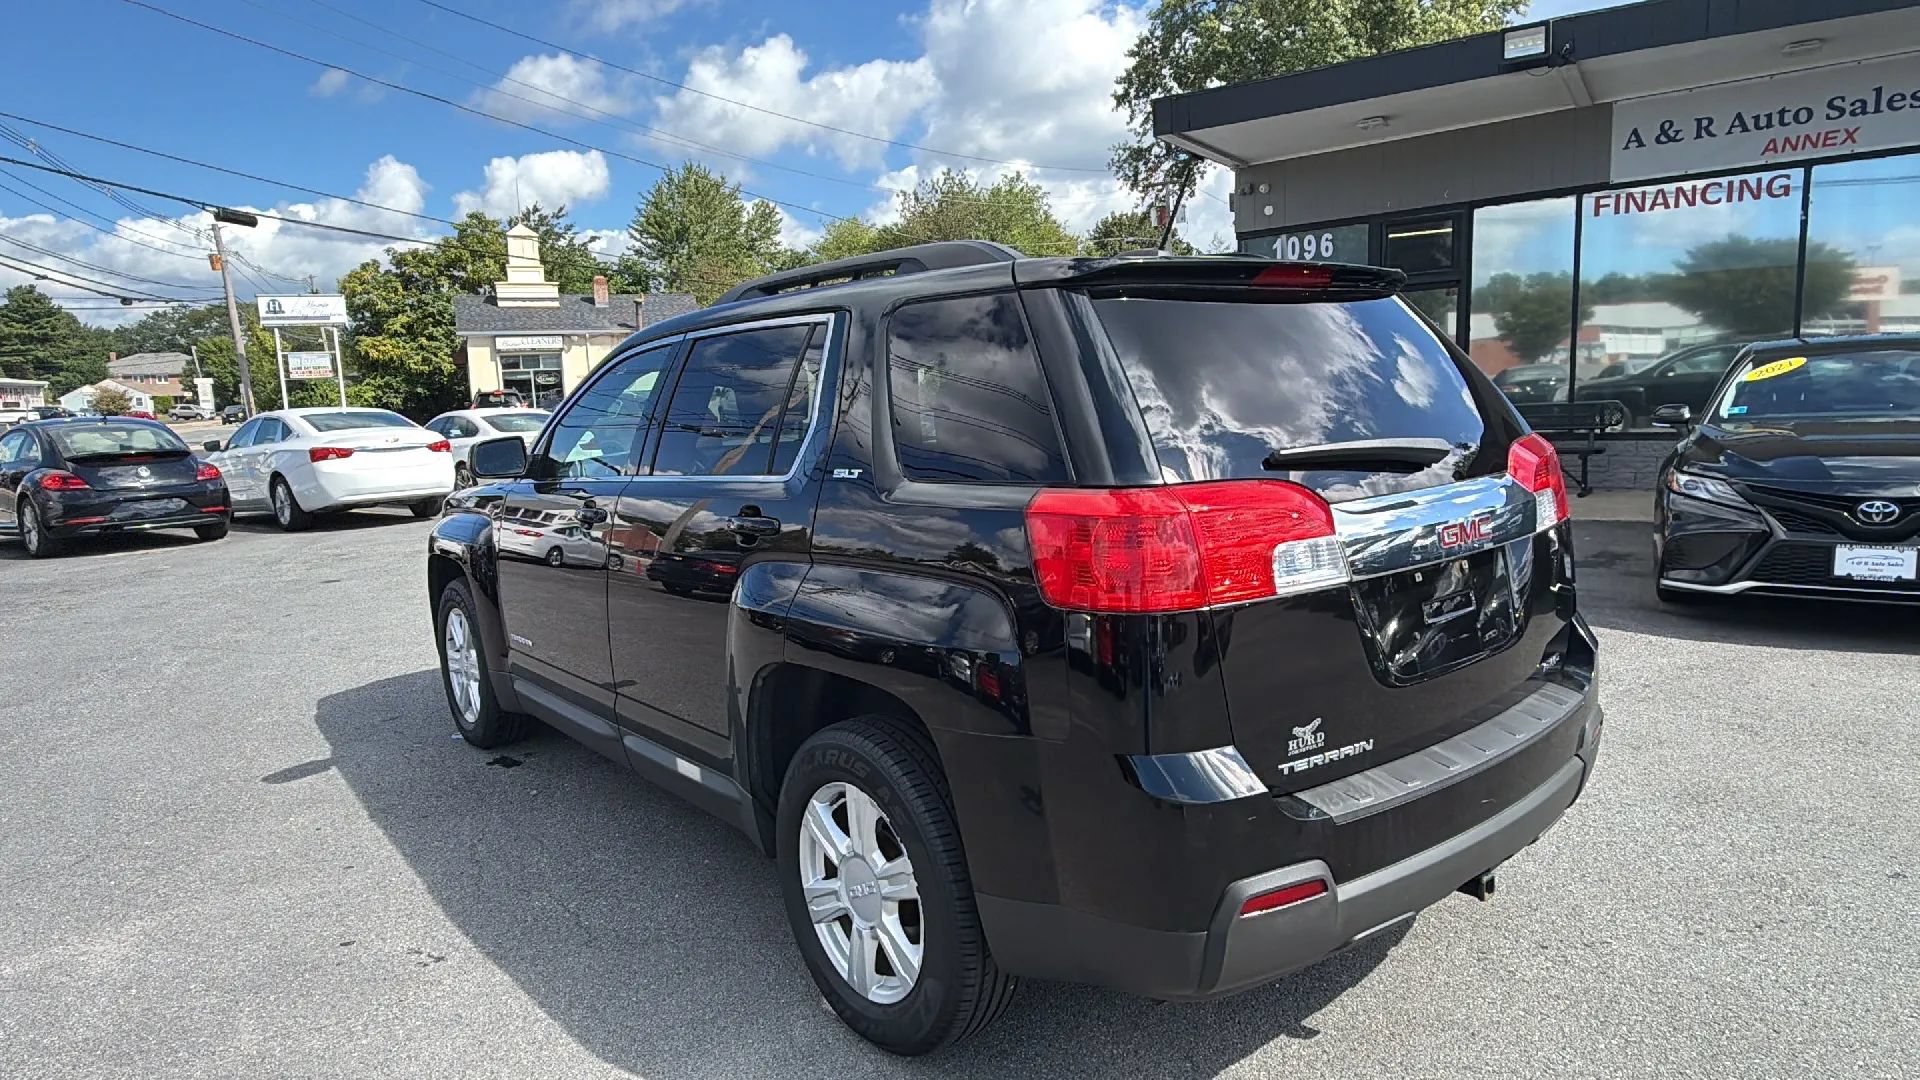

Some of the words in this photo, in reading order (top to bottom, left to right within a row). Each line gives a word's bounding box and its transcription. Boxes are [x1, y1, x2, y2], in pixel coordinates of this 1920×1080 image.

[1622, 127, 1647, 150] A
[1654, 119, 1684, 145] &
[1693, 116, 1718, 141] R
[1725, 105, 1815, 136] Auto
[1760, 126, 1862, 156] ANNEX
[1593, 173, 1792, 217] FINANCING
[1272, 232, 1335, 261] 1096
[1754, 360, 1794, 378] 2021
[832, 468, 863, 479] SLT
[1440, 514, 1492, 548] GMC
[1287, 731, 1325, 751] HURD
[1278, 738, 1374, 775] TERRAIN
